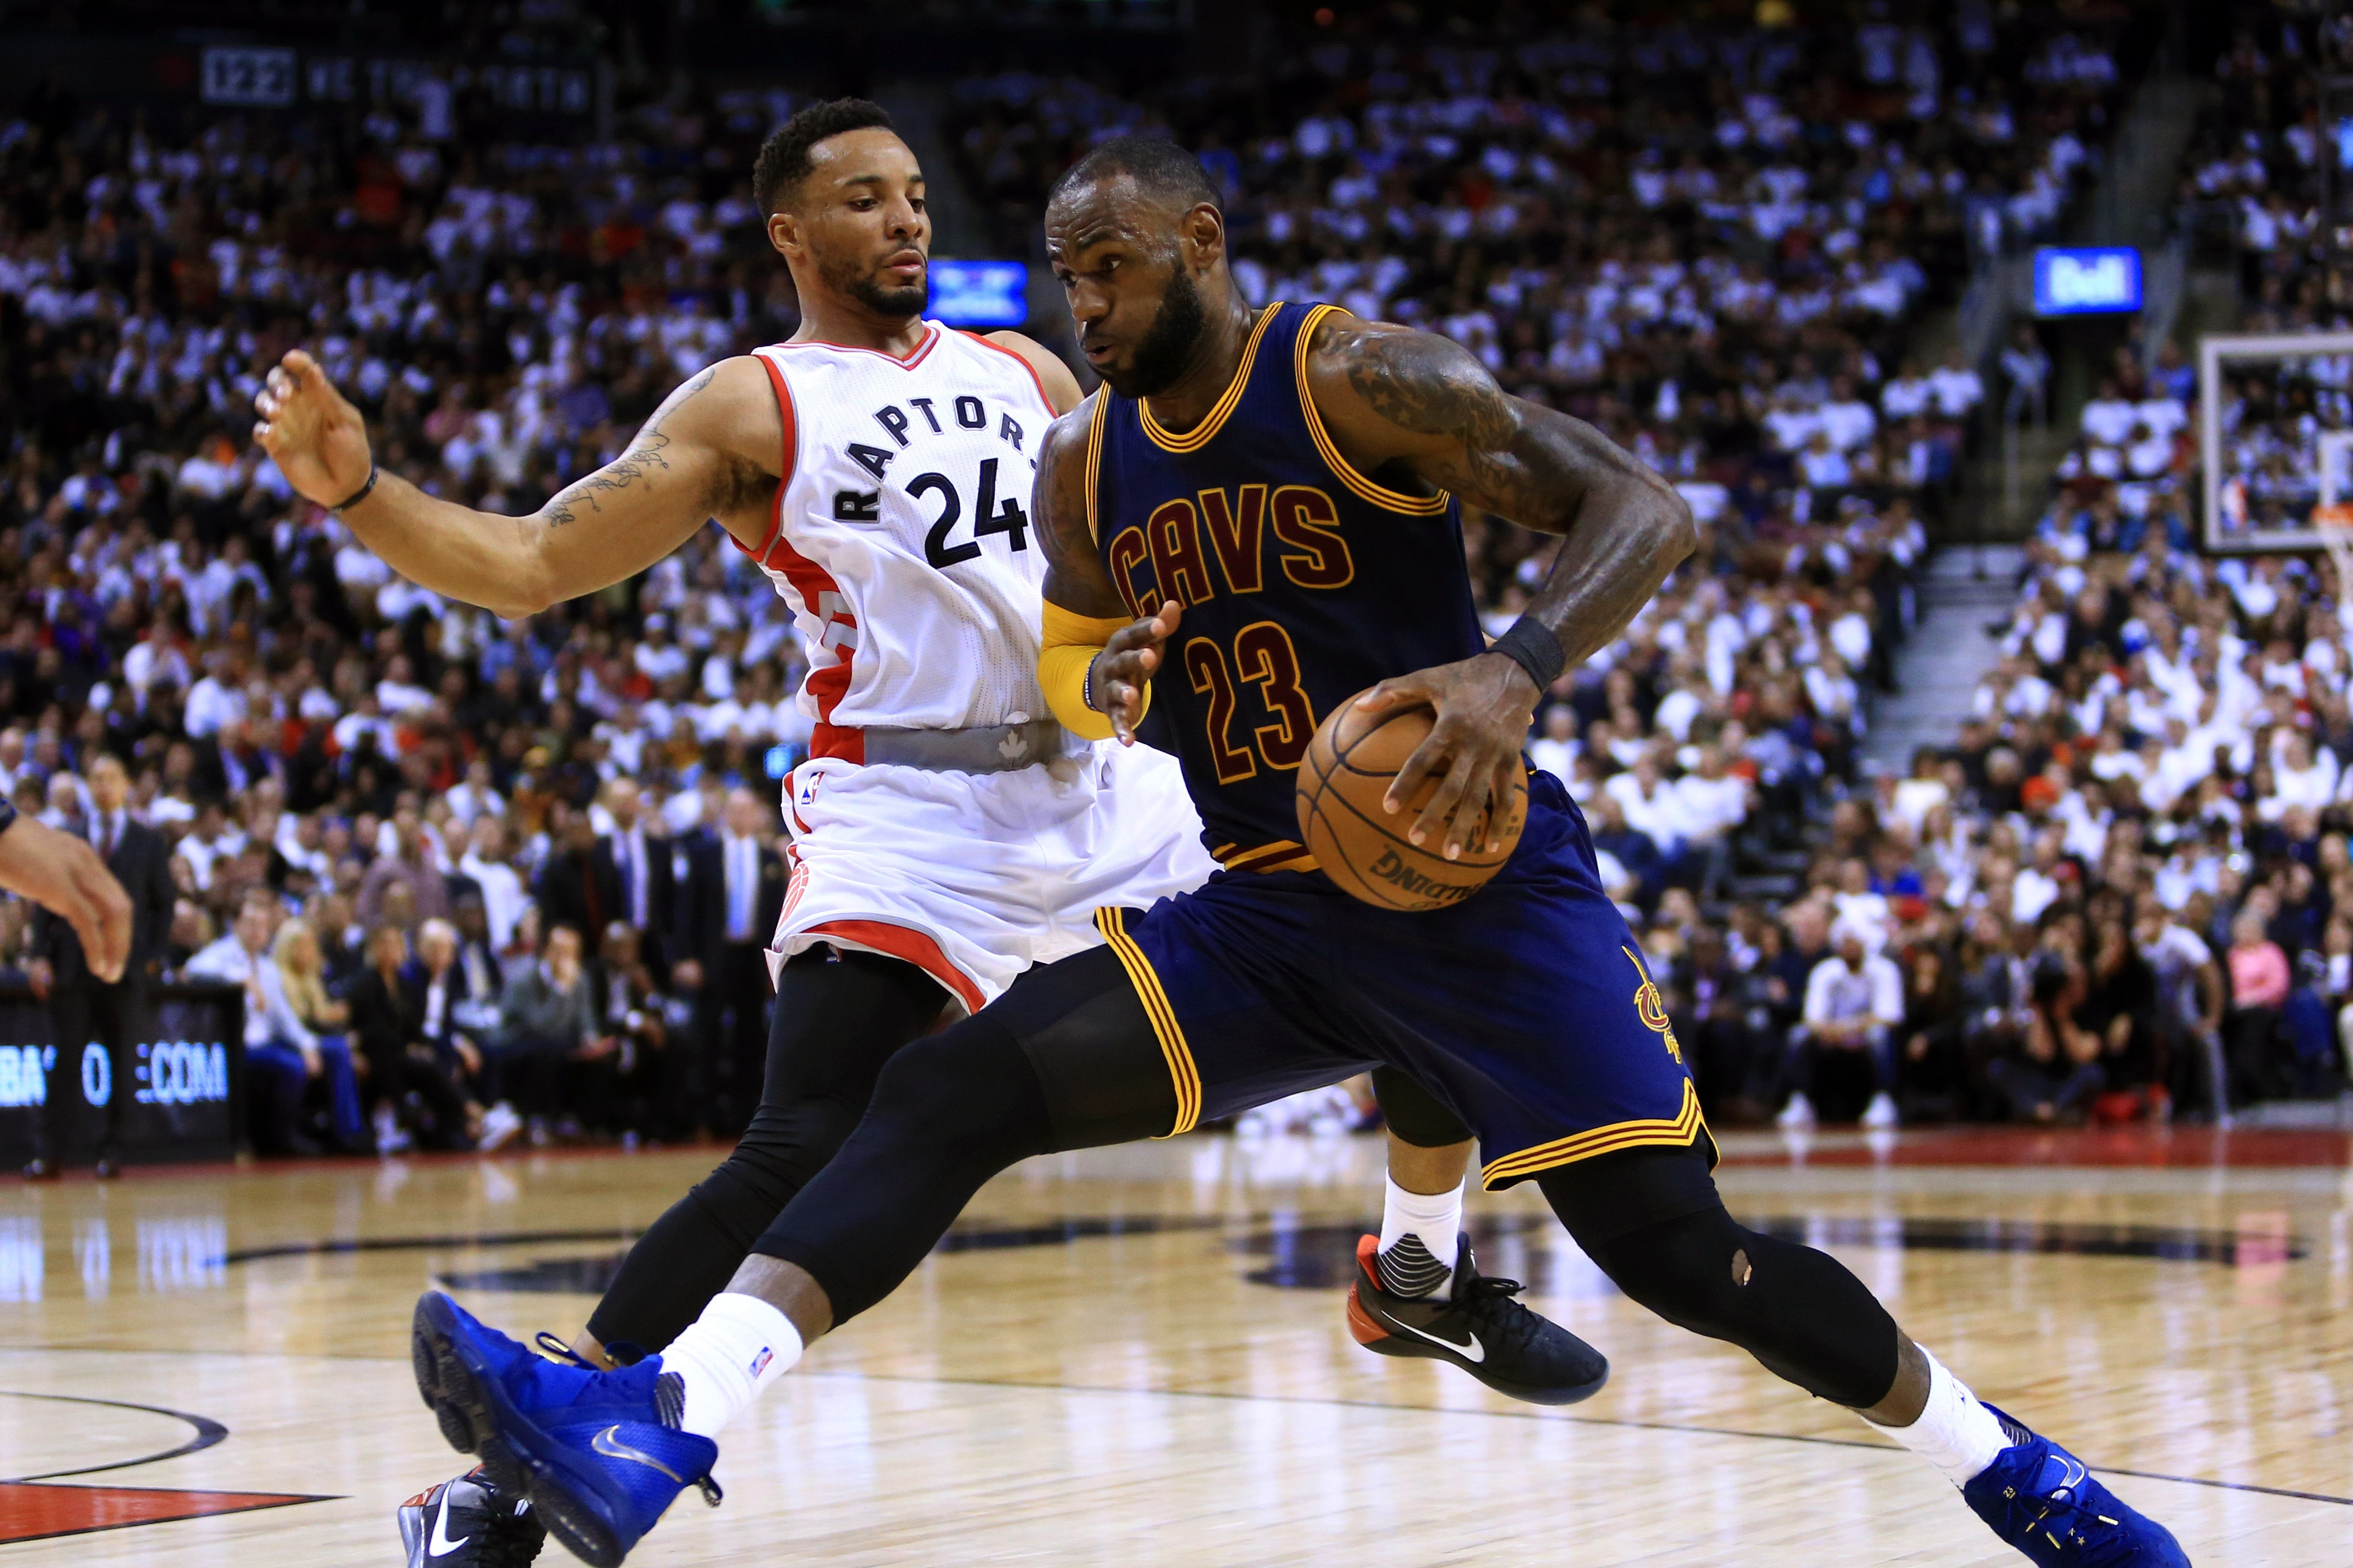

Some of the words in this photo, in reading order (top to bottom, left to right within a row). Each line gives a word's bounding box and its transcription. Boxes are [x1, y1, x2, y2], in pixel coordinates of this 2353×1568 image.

[212, 56, 289, 97] 122
[832, 394, 1038, 523] RAPTOR
[905, 458, 1028, 570] 24
[1110, 484, 1355, 621] CAVS
[1185, 621, 1318, 785] 23
